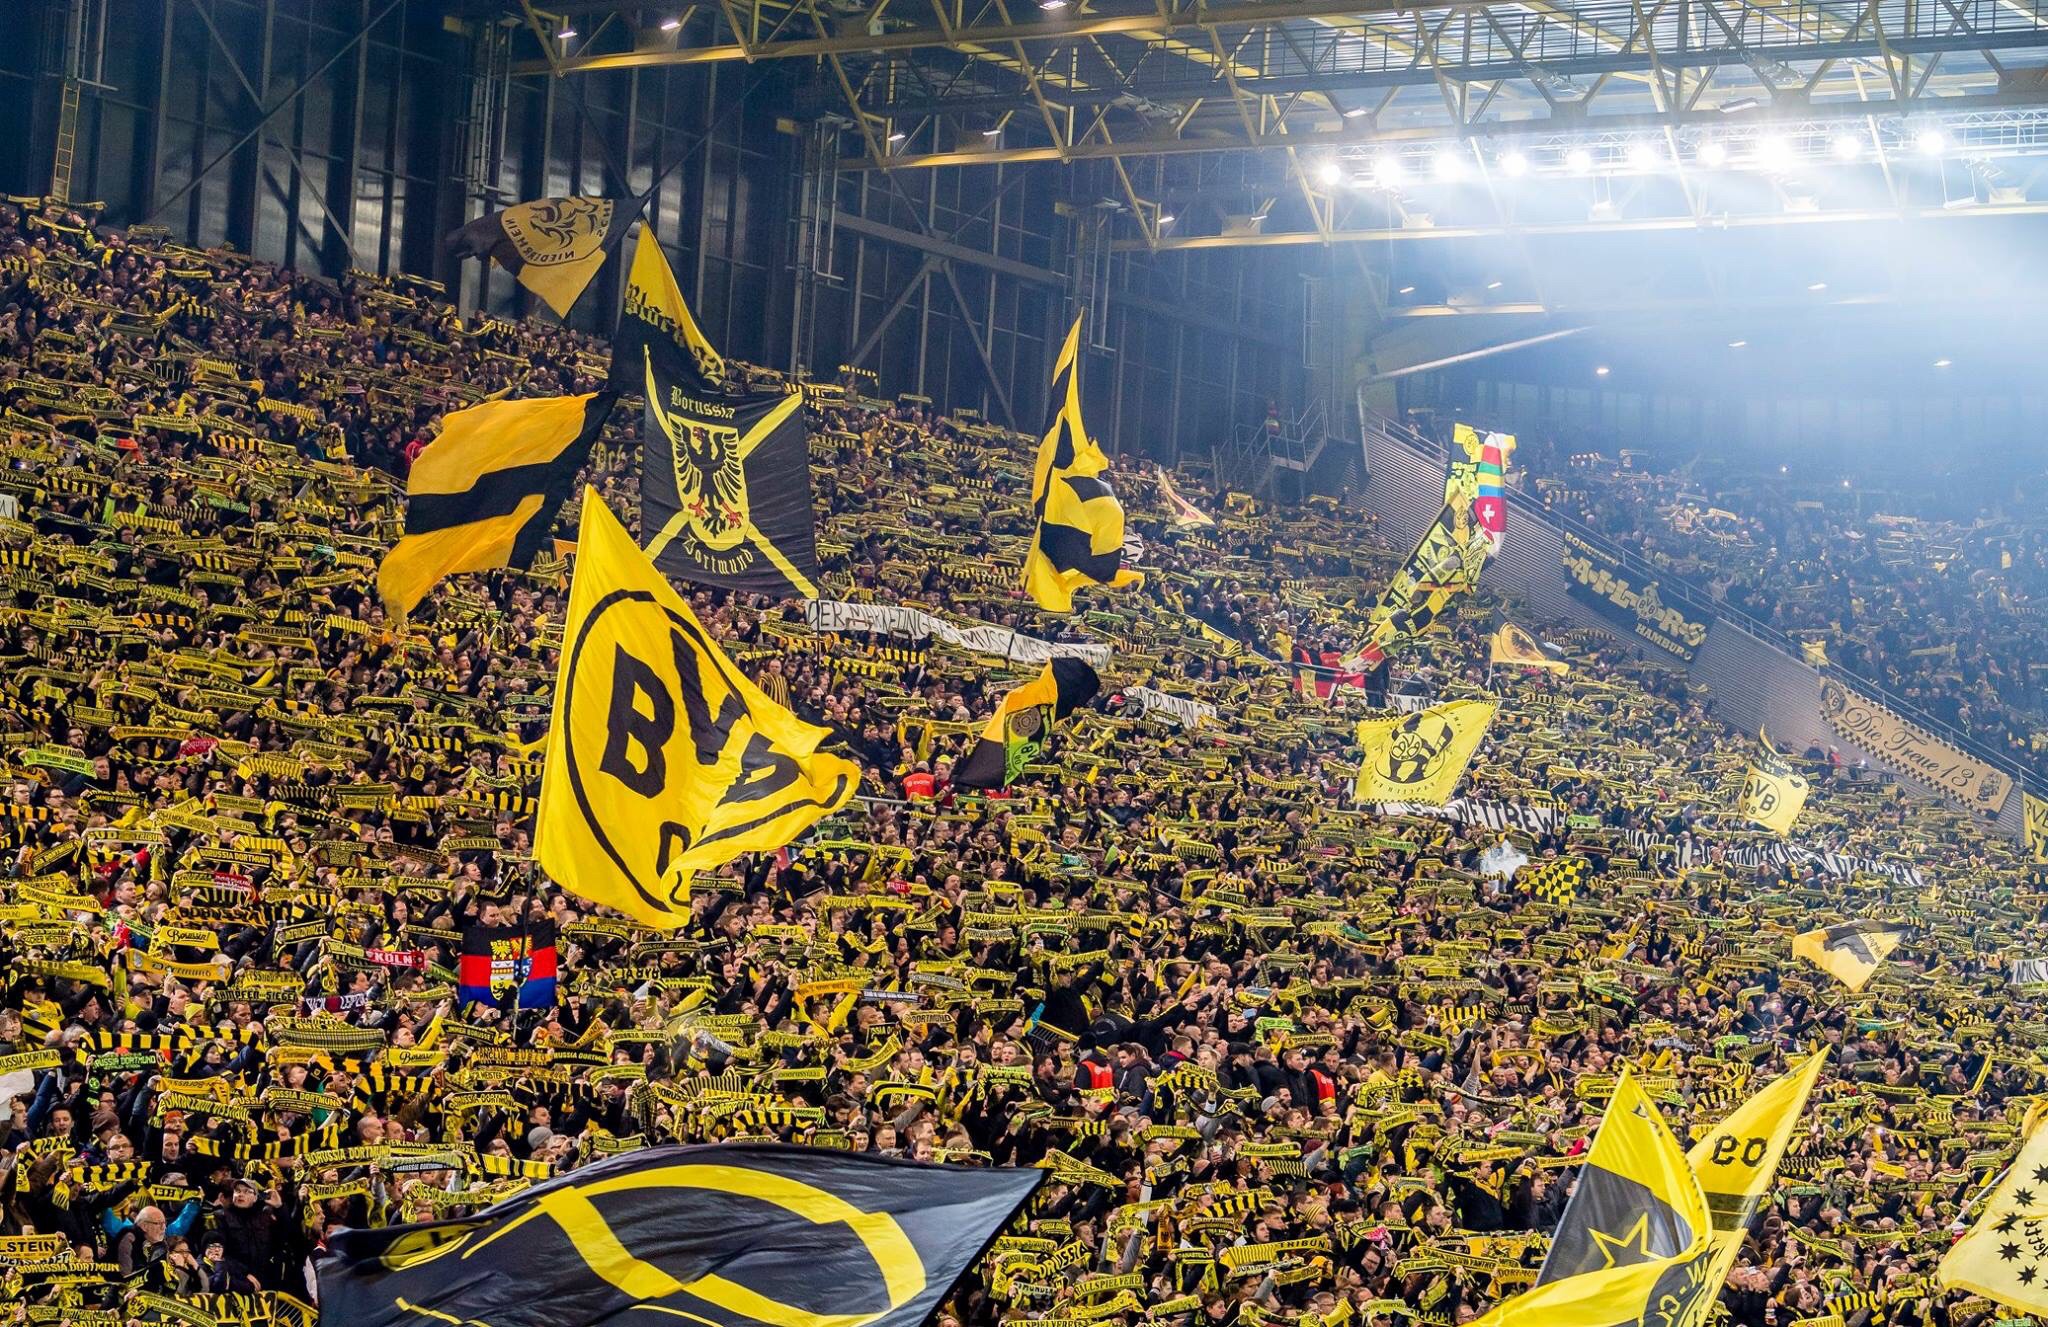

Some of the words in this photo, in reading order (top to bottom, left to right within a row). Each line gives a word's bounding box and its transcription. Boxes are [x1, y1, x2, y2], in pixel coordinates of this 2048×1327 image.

[671, 385, 735, 420] Borussia
[682, 532, 754, 575] Dortmund
[808, 600, 846, 627] DER
[1635, 623, 1694, 661] HAMBURG
[1840, 707, 1884, 742] Die
[1883, 727, 1941, 773] Treue
[1743, 779, 1776, 812] BVB
[200, 849, 234, 861] BORUSSIA
[235, 853, 270, 865] DORTMUND
[374, 952, 413, 965] KÖLN
[305, 1149, 347, 1166] BORUSSIA
